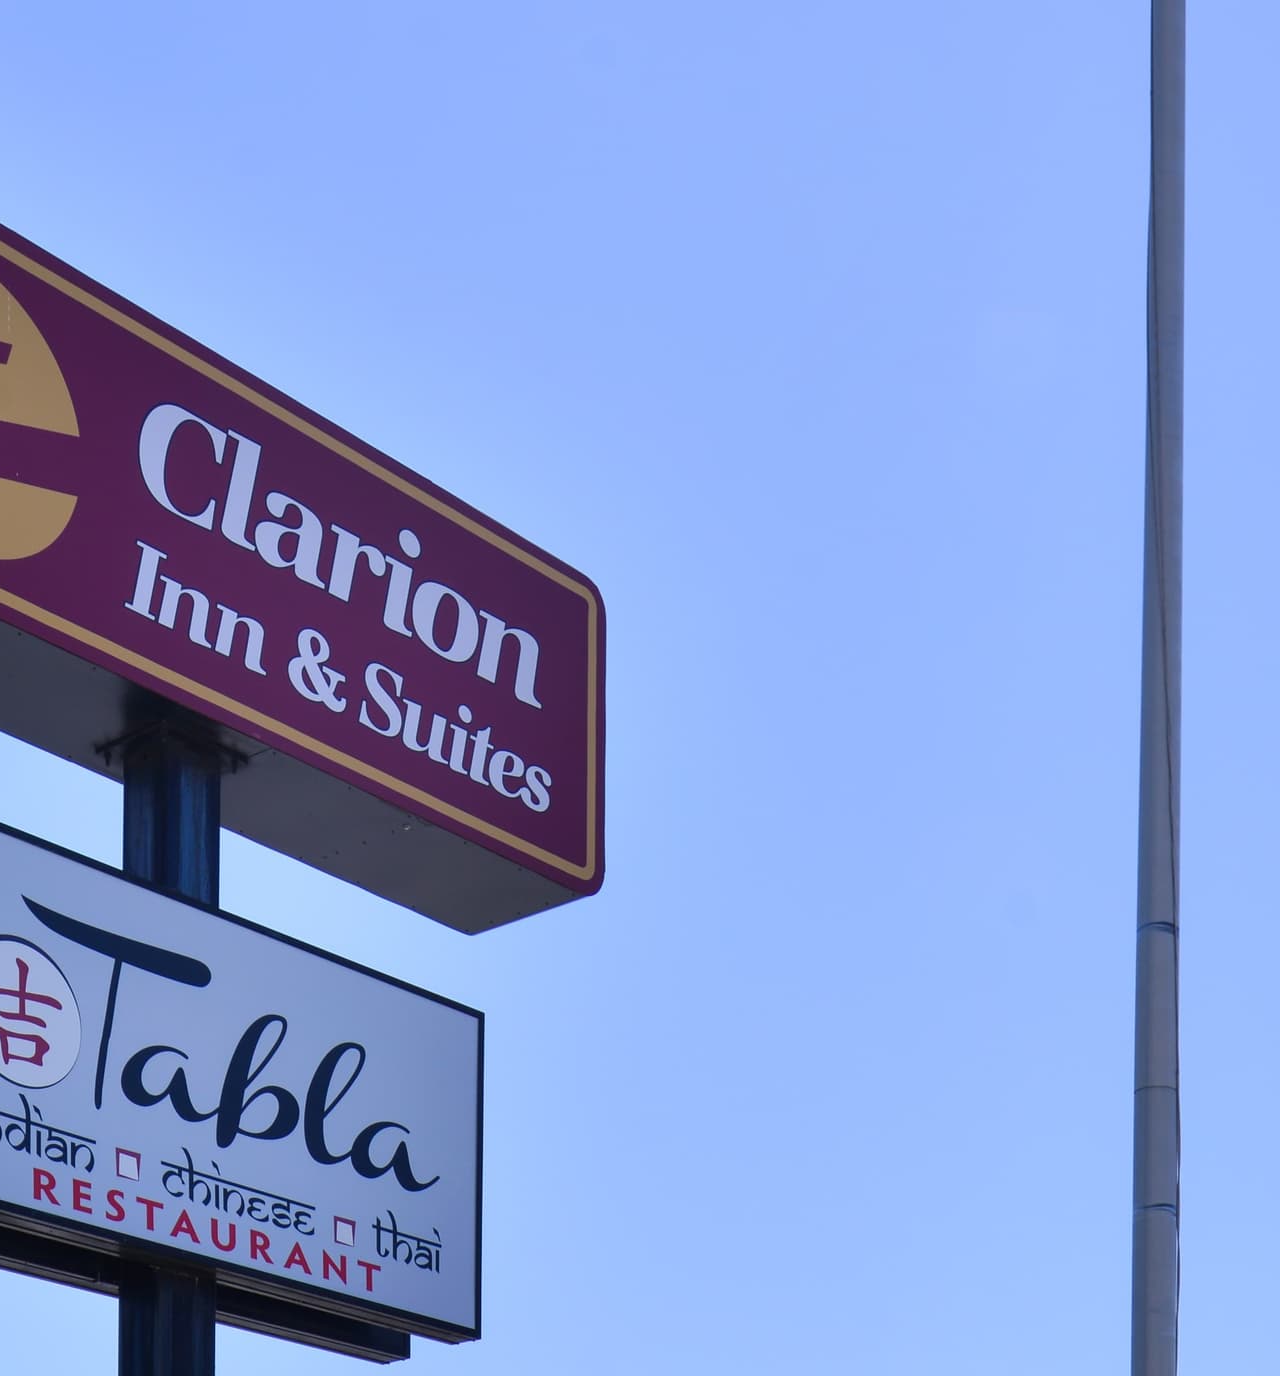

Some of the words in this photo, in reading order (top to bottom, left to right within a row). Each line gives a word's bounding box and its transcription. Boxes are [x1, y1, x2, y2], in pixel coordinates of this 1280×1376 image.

[124, 539, 268, 677] Inn
[287, 627, 348, 713] &
[358, 661, 553, 813] Suites
[138, 402, 543, 710] Clarion
[20, 893, 441, 1193] Tabla
[31, 1166, 382, 1293] RESTAURANT
[160, 1146, 317, 1236] chinese
[371, 1209, 443, 1273] thai
